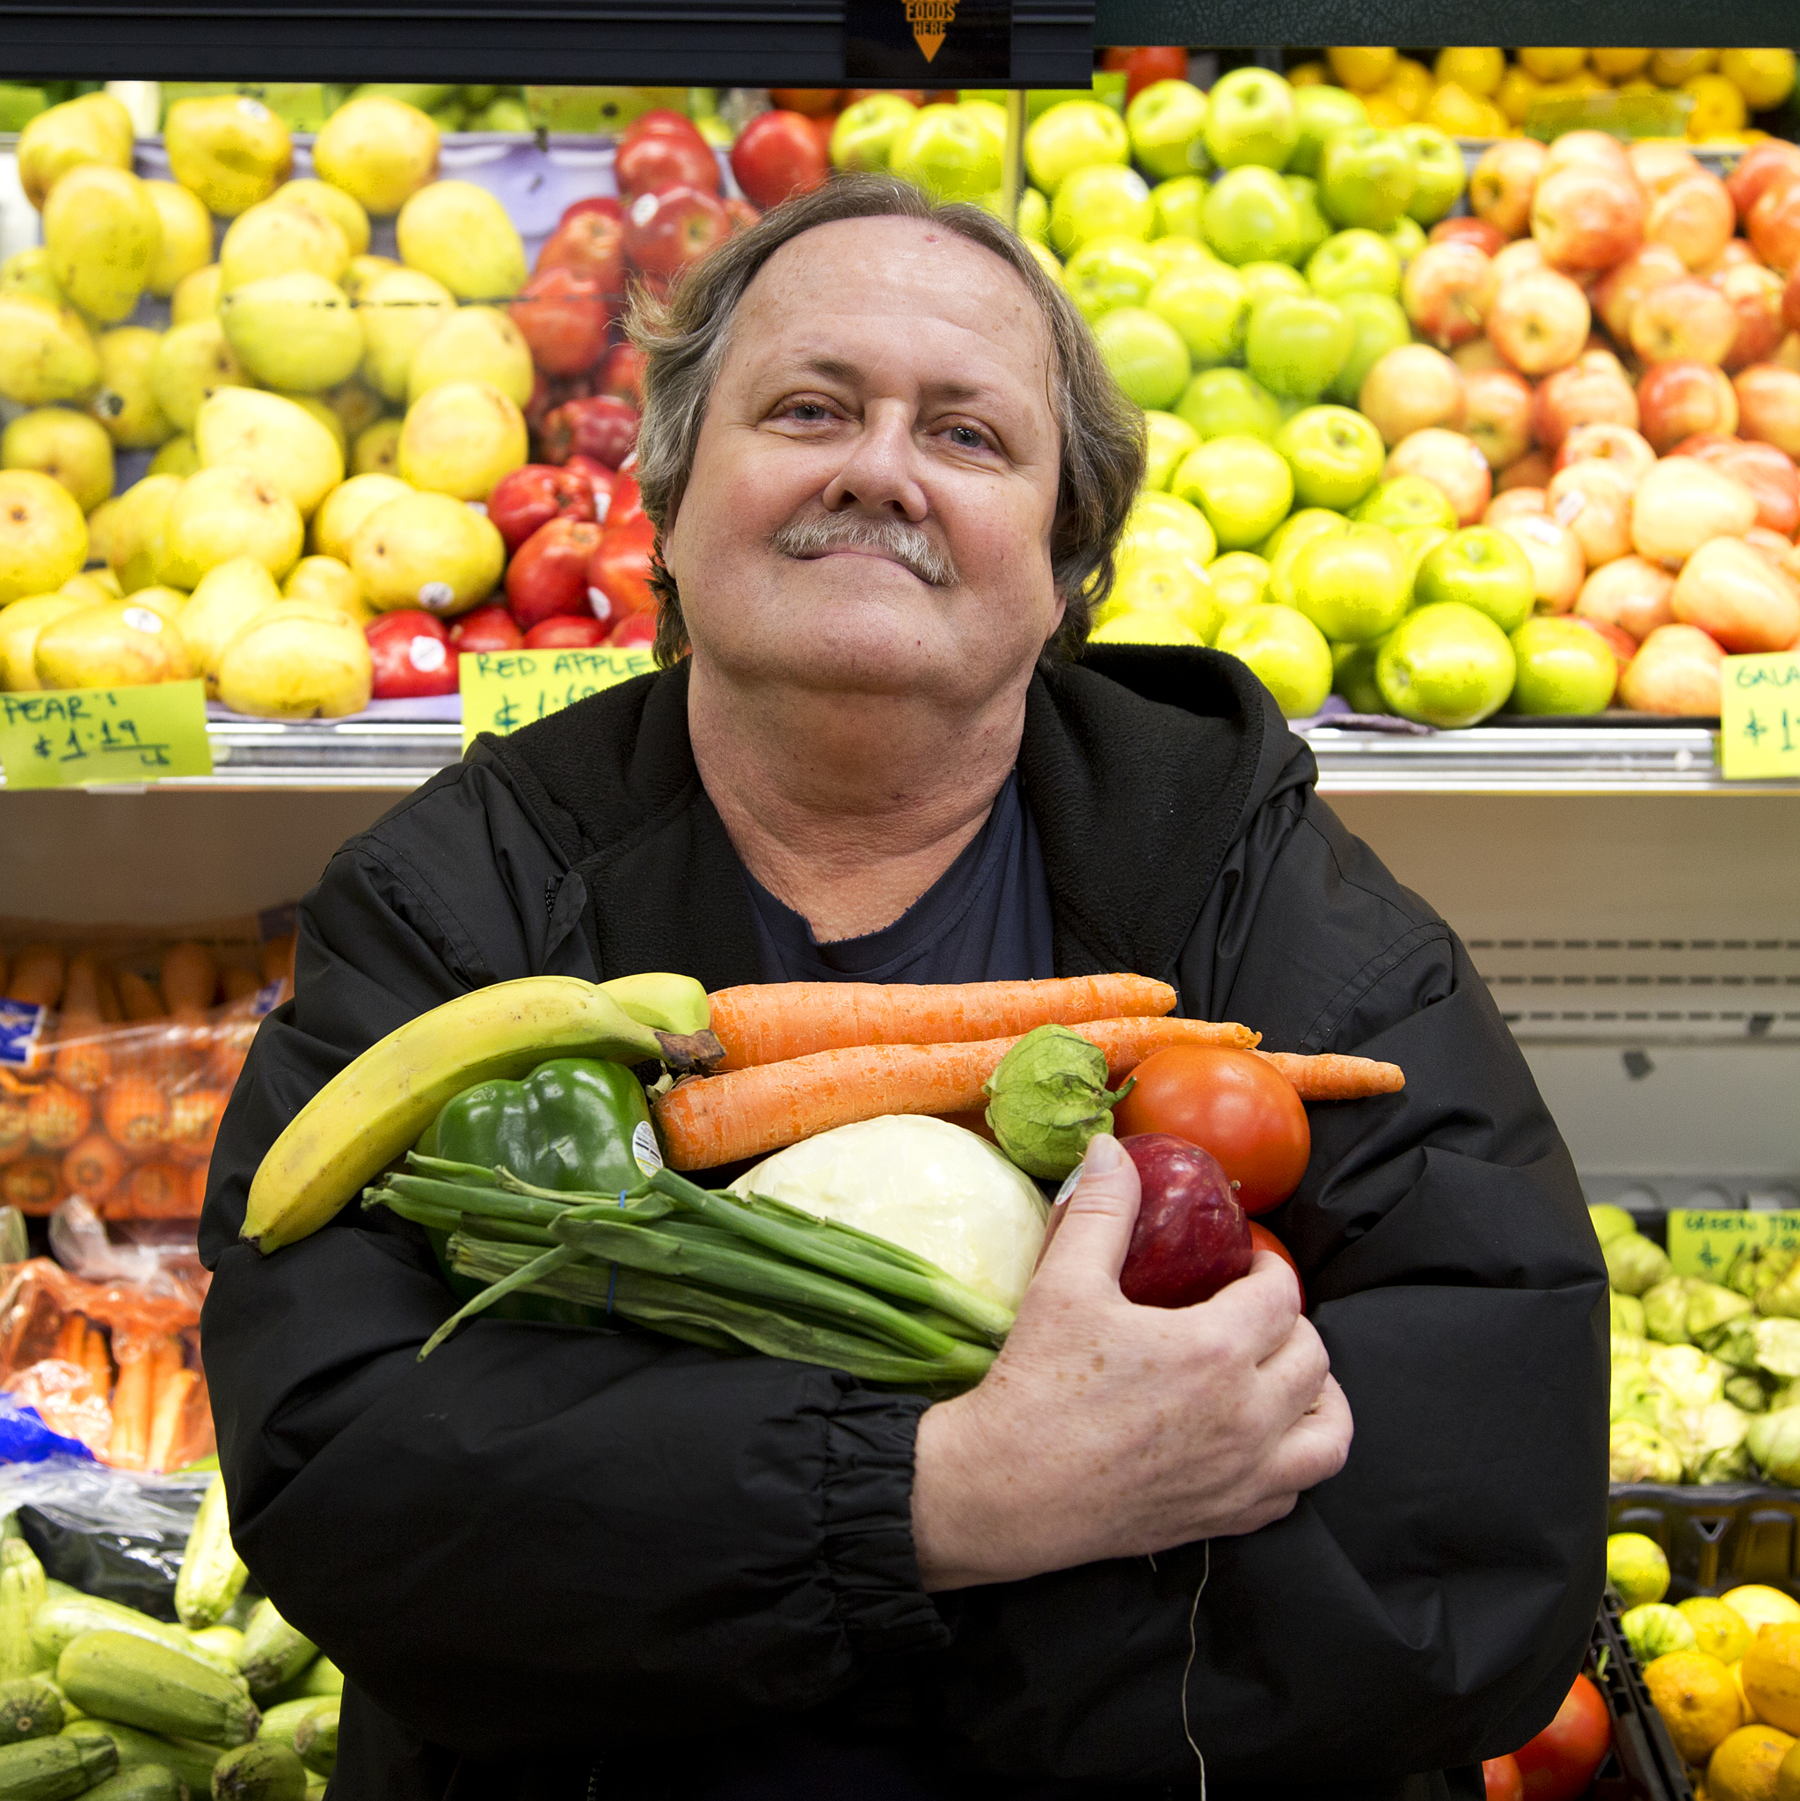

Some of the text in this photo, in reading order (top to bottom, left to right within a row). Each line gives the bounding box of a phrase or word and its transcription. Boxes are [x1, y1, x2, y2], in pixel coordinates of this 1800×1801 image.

[906, 2, 956, 21] FOODS
[914, 21, 946, 35] HERE
[477, 653, 650, 678] RED APPLE
